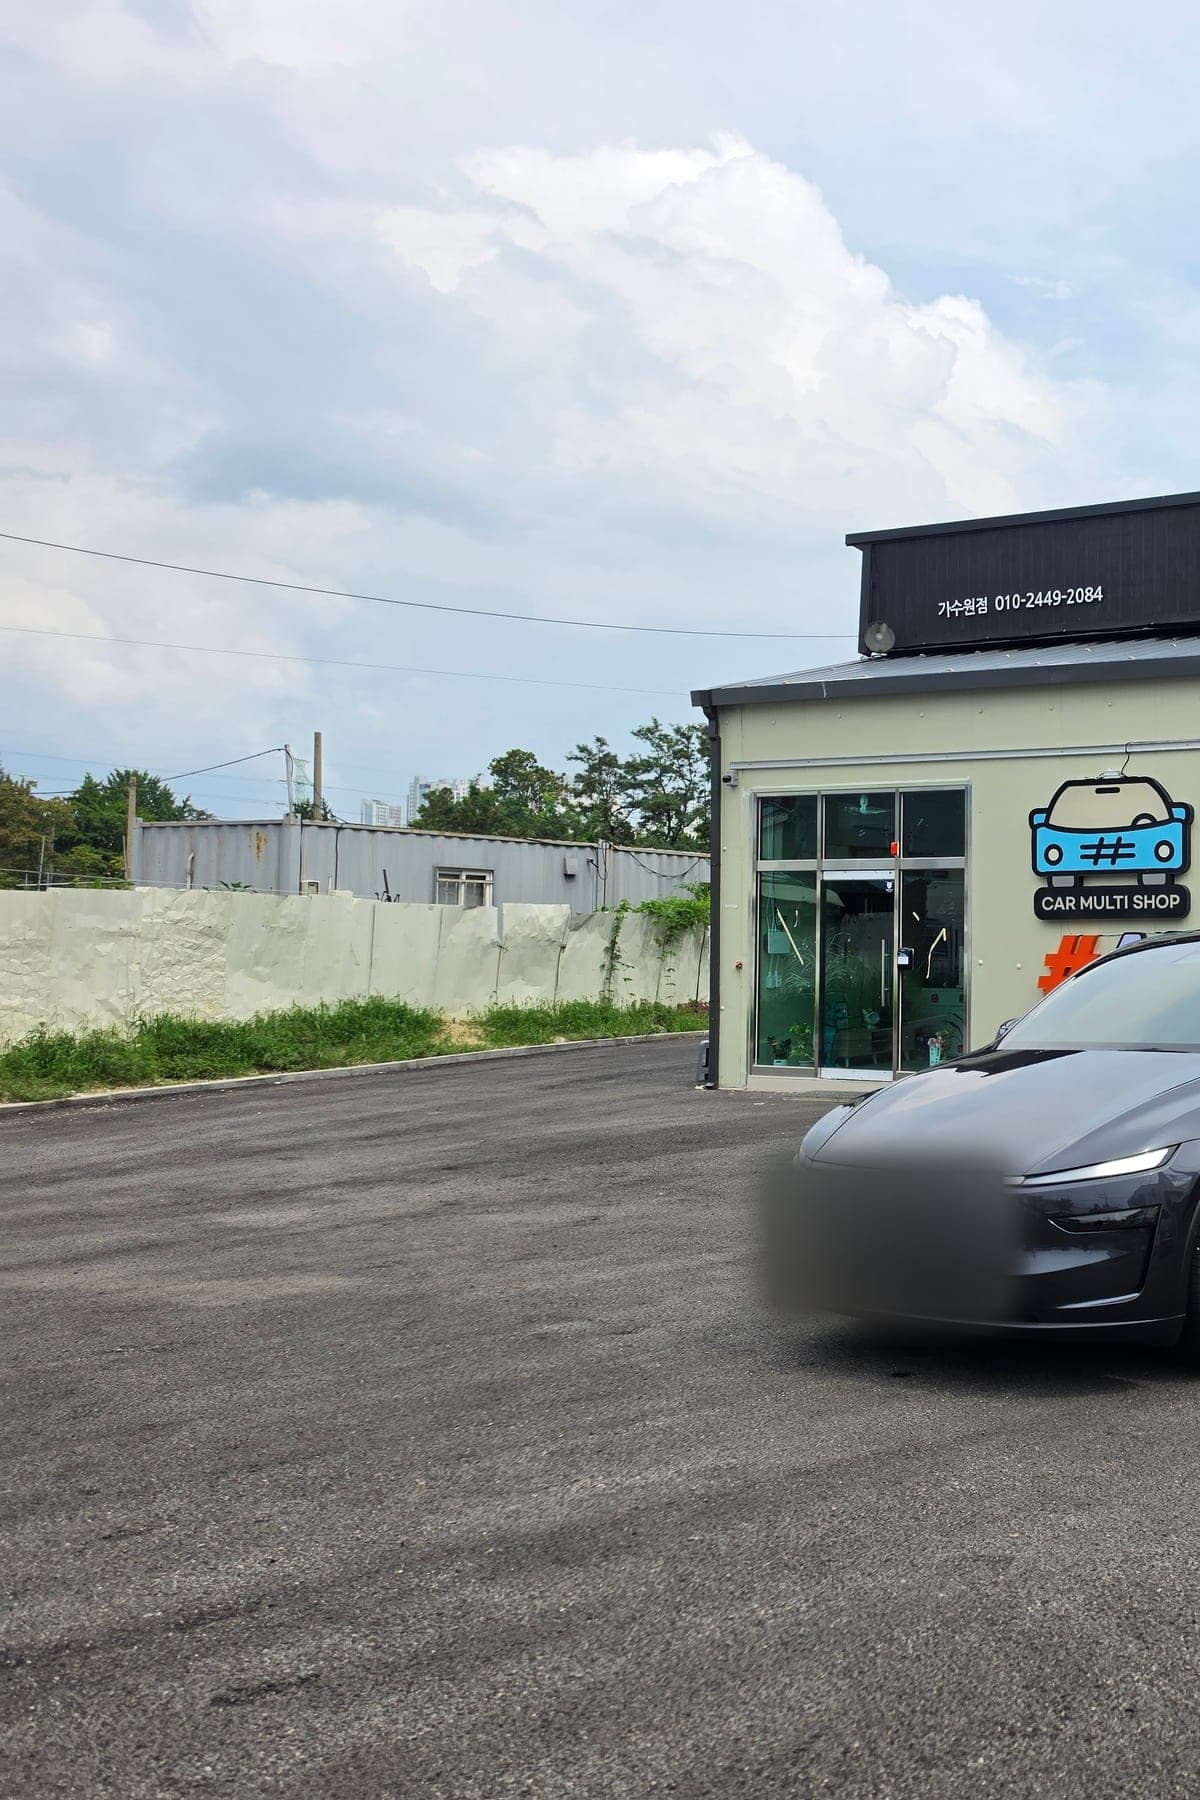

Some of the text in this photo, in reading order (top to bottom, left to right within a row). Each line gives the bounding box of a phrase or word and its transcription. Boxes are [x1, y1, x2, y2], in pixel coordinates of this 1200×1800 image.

[937, 585, 1104, 618] 가수원점 010-2449-2084
[1041, 894, 1181, 911] CAR MULTI SHOP
